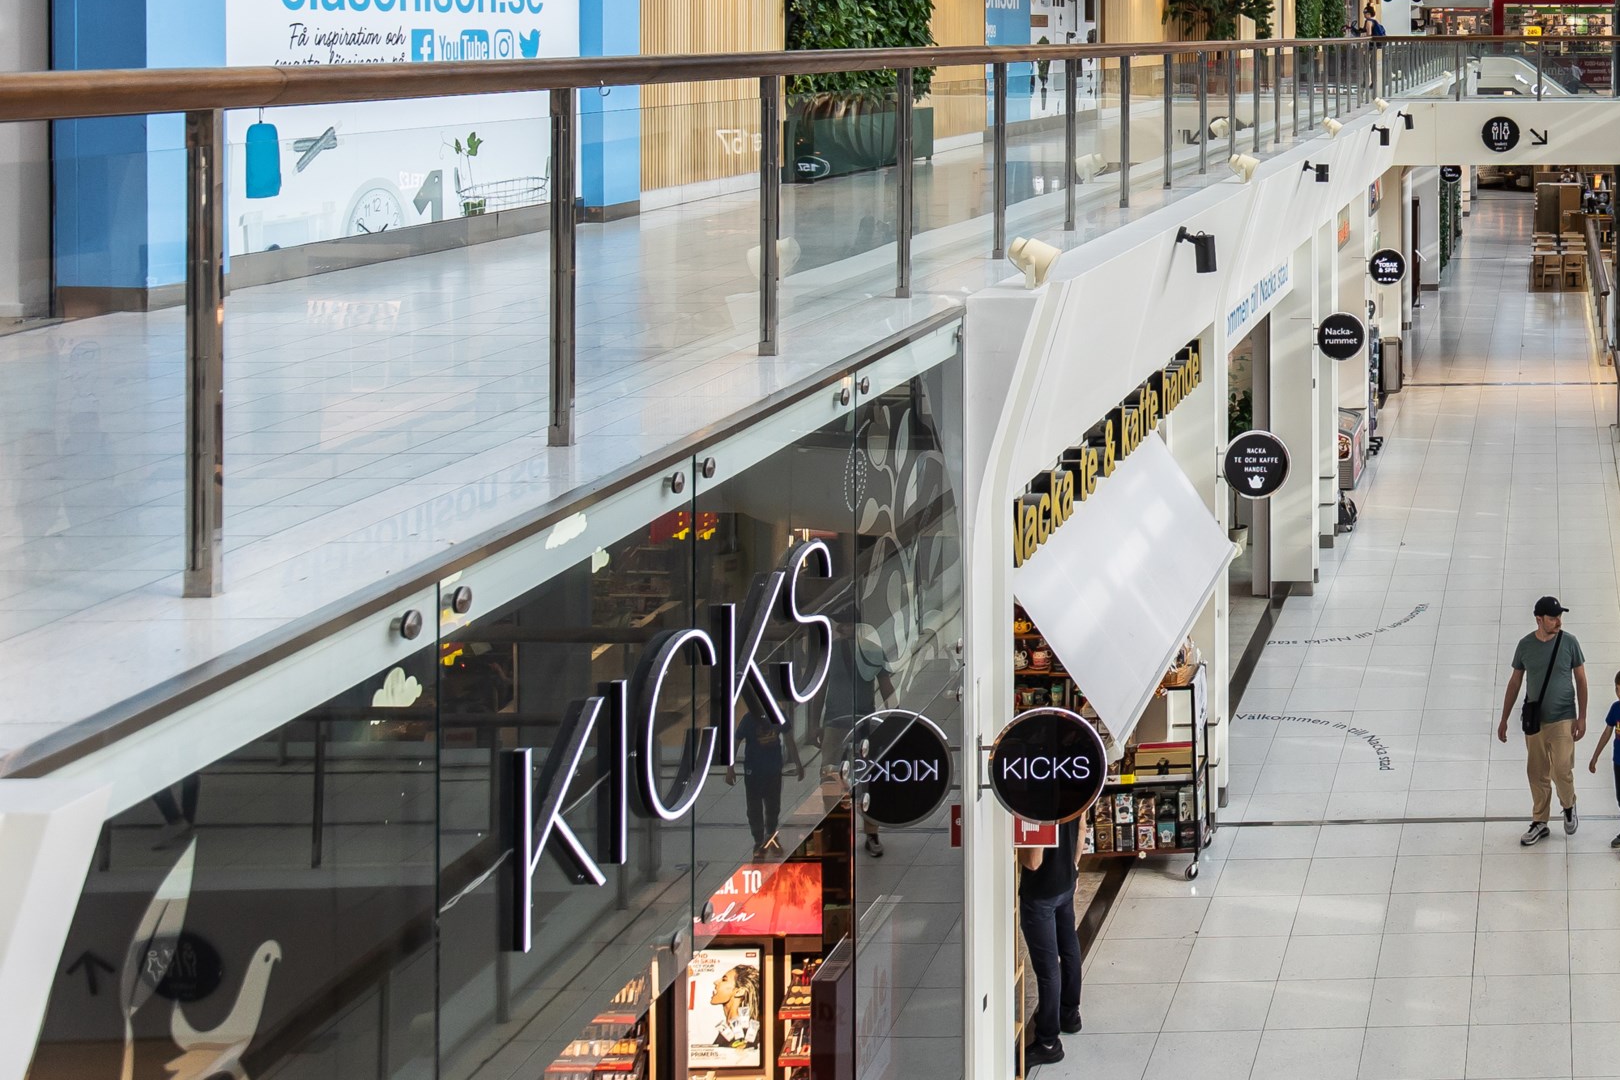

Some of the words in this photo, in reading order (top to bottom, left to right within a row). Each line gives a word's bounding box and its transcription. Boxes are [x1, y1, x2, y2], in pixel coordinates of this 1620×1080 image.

[289, 22, 309, 49] Få
[314, 27, 382, 53] inspiration
[386, 26, 406, 46] och
[1325, 327, 1354, 337] Nacka-
[1325, 337, 1358, 345] rummet
[1081, 445, 1098, 501] te
[1104, 419, 1116, 478] &
[1122, 382, 1158, 460] kaffe
[1163, 338, 1203, 418] handel
[1304, 636, 1351, 645] Nacka
[513, 538, 833, 953] KICKS
[1236, 713, 1330, 726] Välkommen
[1333, 721, 1347, 730] in
[1348, 727, 1369, 739] till
[1363, 735, 1389, 756] Nacka
[1378, 756, 1394, 771] stad
[1003, 756, 1091, 780] KICKS
